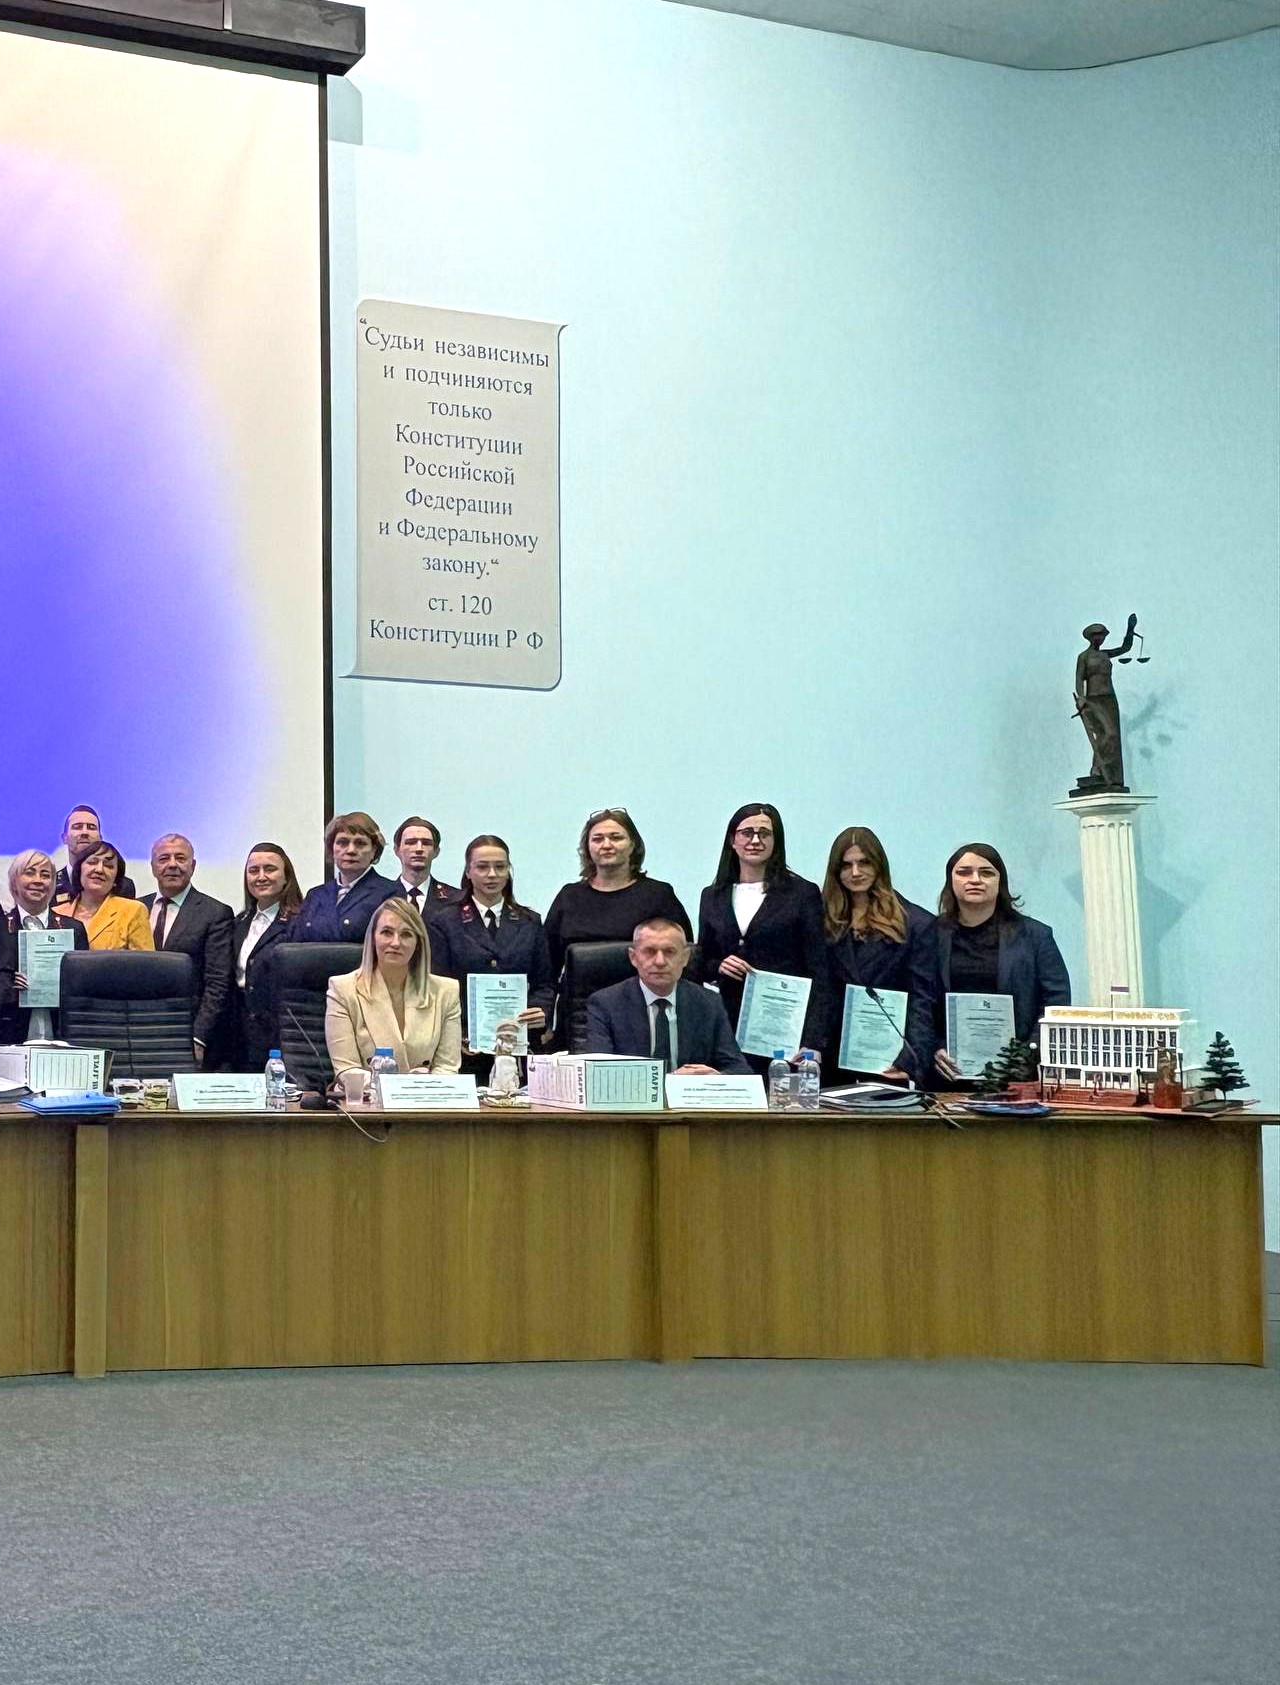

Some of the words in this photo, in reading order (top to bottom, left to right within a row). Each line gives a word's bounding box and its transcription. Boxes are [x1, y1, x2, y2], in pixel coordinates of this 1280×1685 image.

[436, 341, 548, 367] независимы
[384, 365, 394, 379] и
[406, 368, 532, 395] подчиняются
[428, 402, 492, 420] только
[397, 424, 522, 455] Конституции
[405, 455, 515, 485] Российской
[406, 488, 512, 516] Федерации
[379, 522, 389, 535] и
[397, 519, 538, 553] Федеральному
[429, 598, 453, 612] ст.
[462, 595, 492, 615] 120
[371, 620, 499, 648] Конституции
[507, 630, 517, 648] Р
[527, 632, 543, 649] Ф
